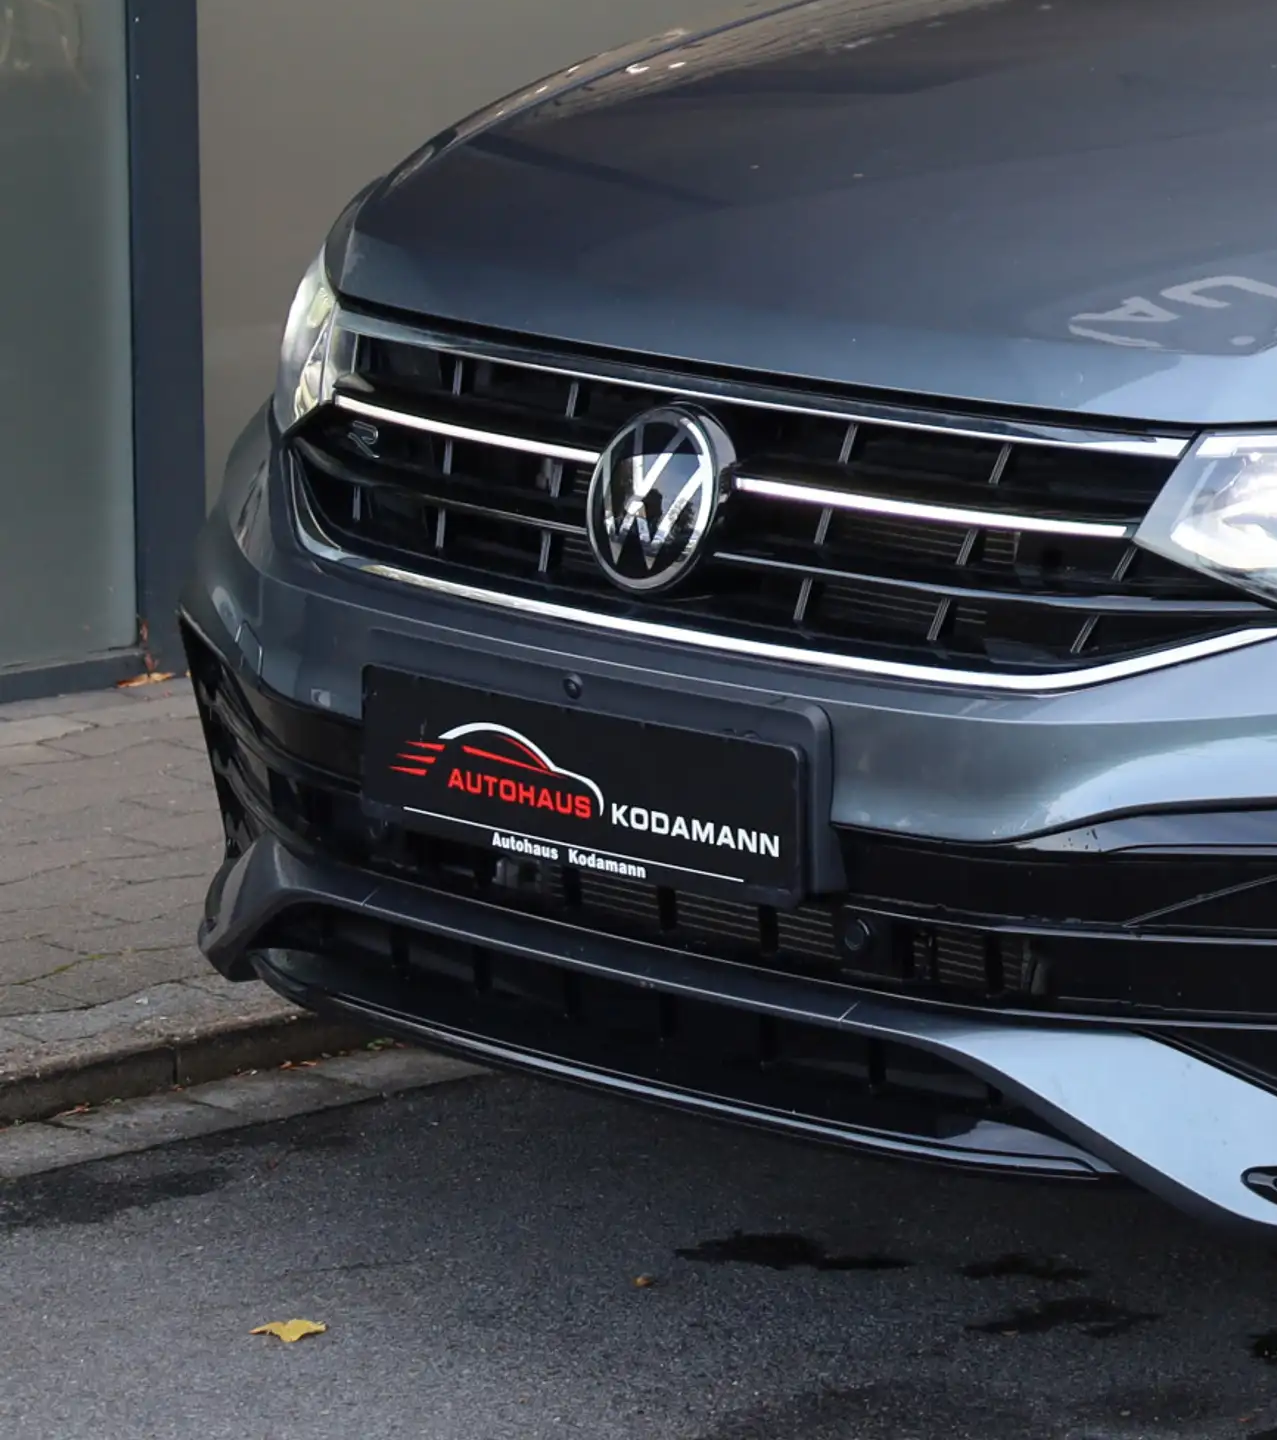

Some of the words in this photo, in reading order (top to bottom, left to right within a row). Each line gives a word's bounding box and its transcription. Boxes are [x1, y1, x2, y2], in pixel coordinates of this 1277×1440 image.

[447, 767, 592, 820] AUTOHAUS
[611, 801, 780, 858] KODAMANN
[491, 831, 560, 861] Autohaus
[567, 846, 647, 880] Kodamann
